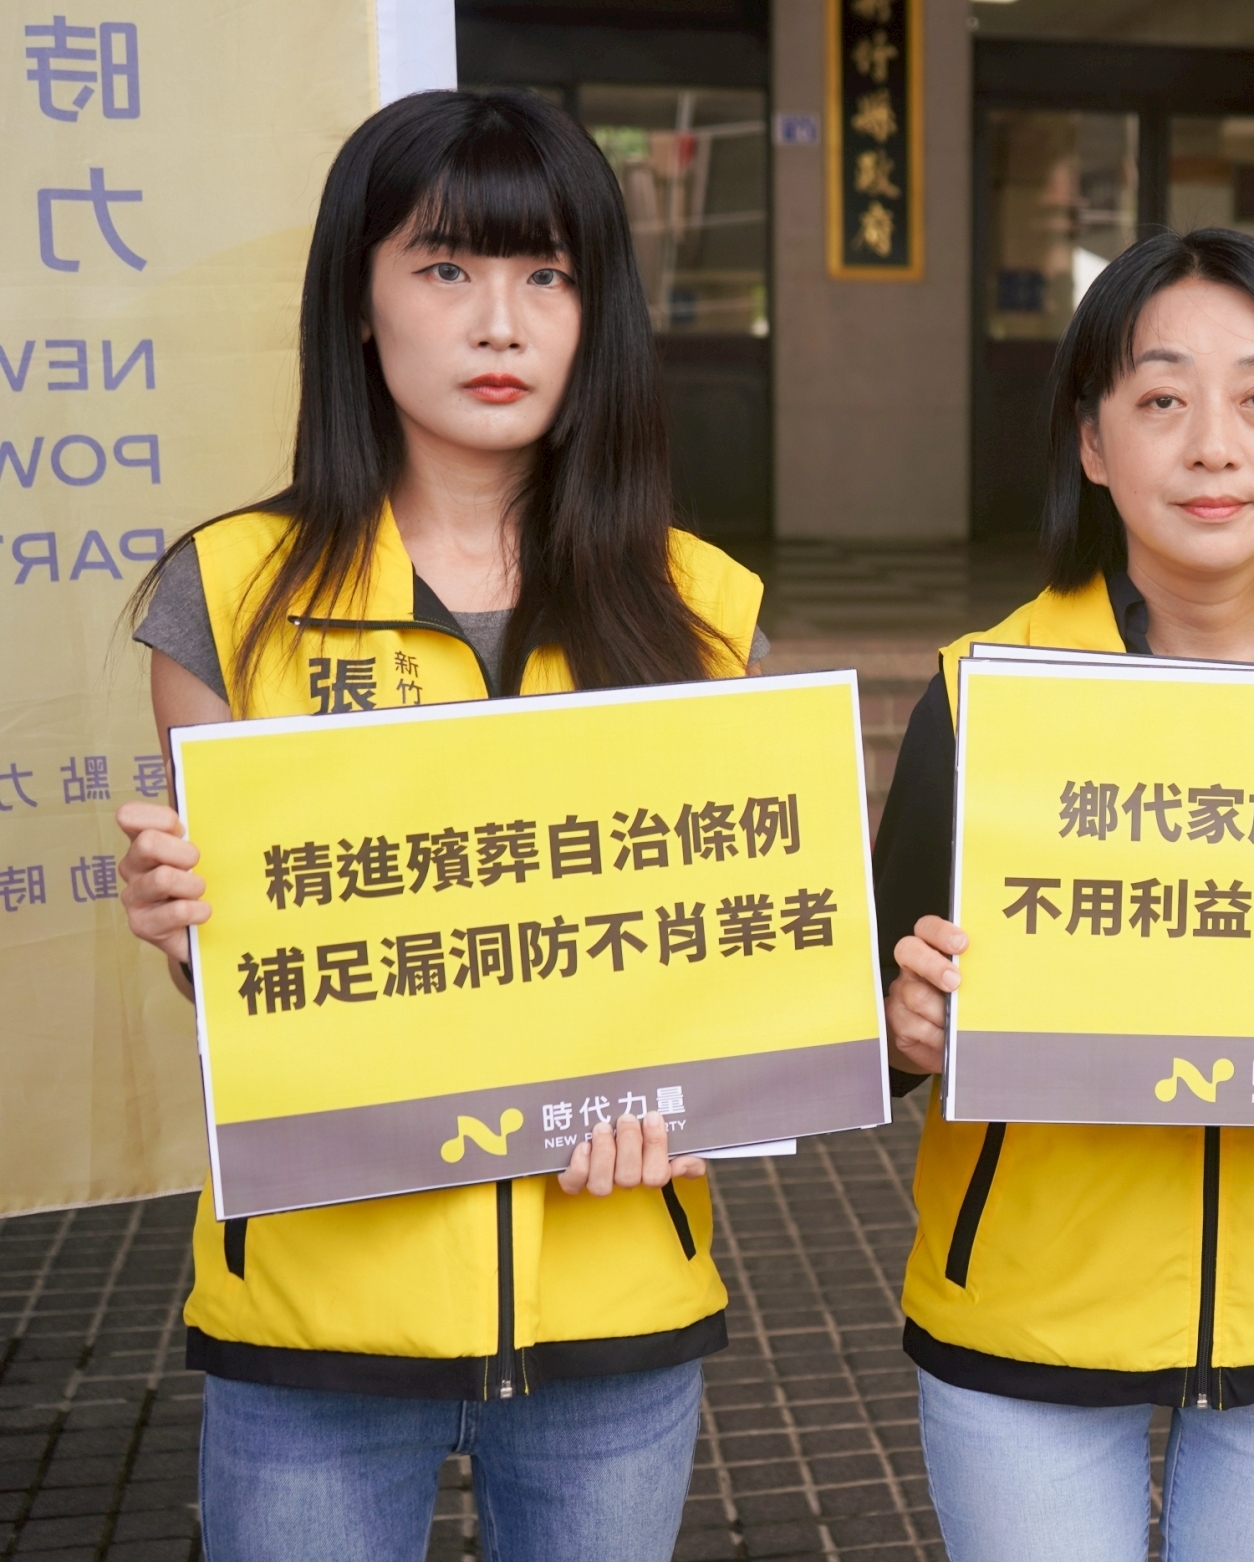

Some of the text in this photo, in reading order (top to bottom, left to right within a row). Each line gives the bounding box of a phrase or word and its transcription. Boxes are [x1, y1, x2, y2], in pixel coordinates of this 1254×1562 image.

[309, 656, 377, 715] 張
[395, 651, 423, 705] 新竹
[263, 793, 801, 910] 精進殯葬自治條例
[237, 887, 838, 1016] 補足漏洞防不肖業者
[542, 1085, 686, 1132] 時代力量
[544, 1134, 577, 1149] NEW
